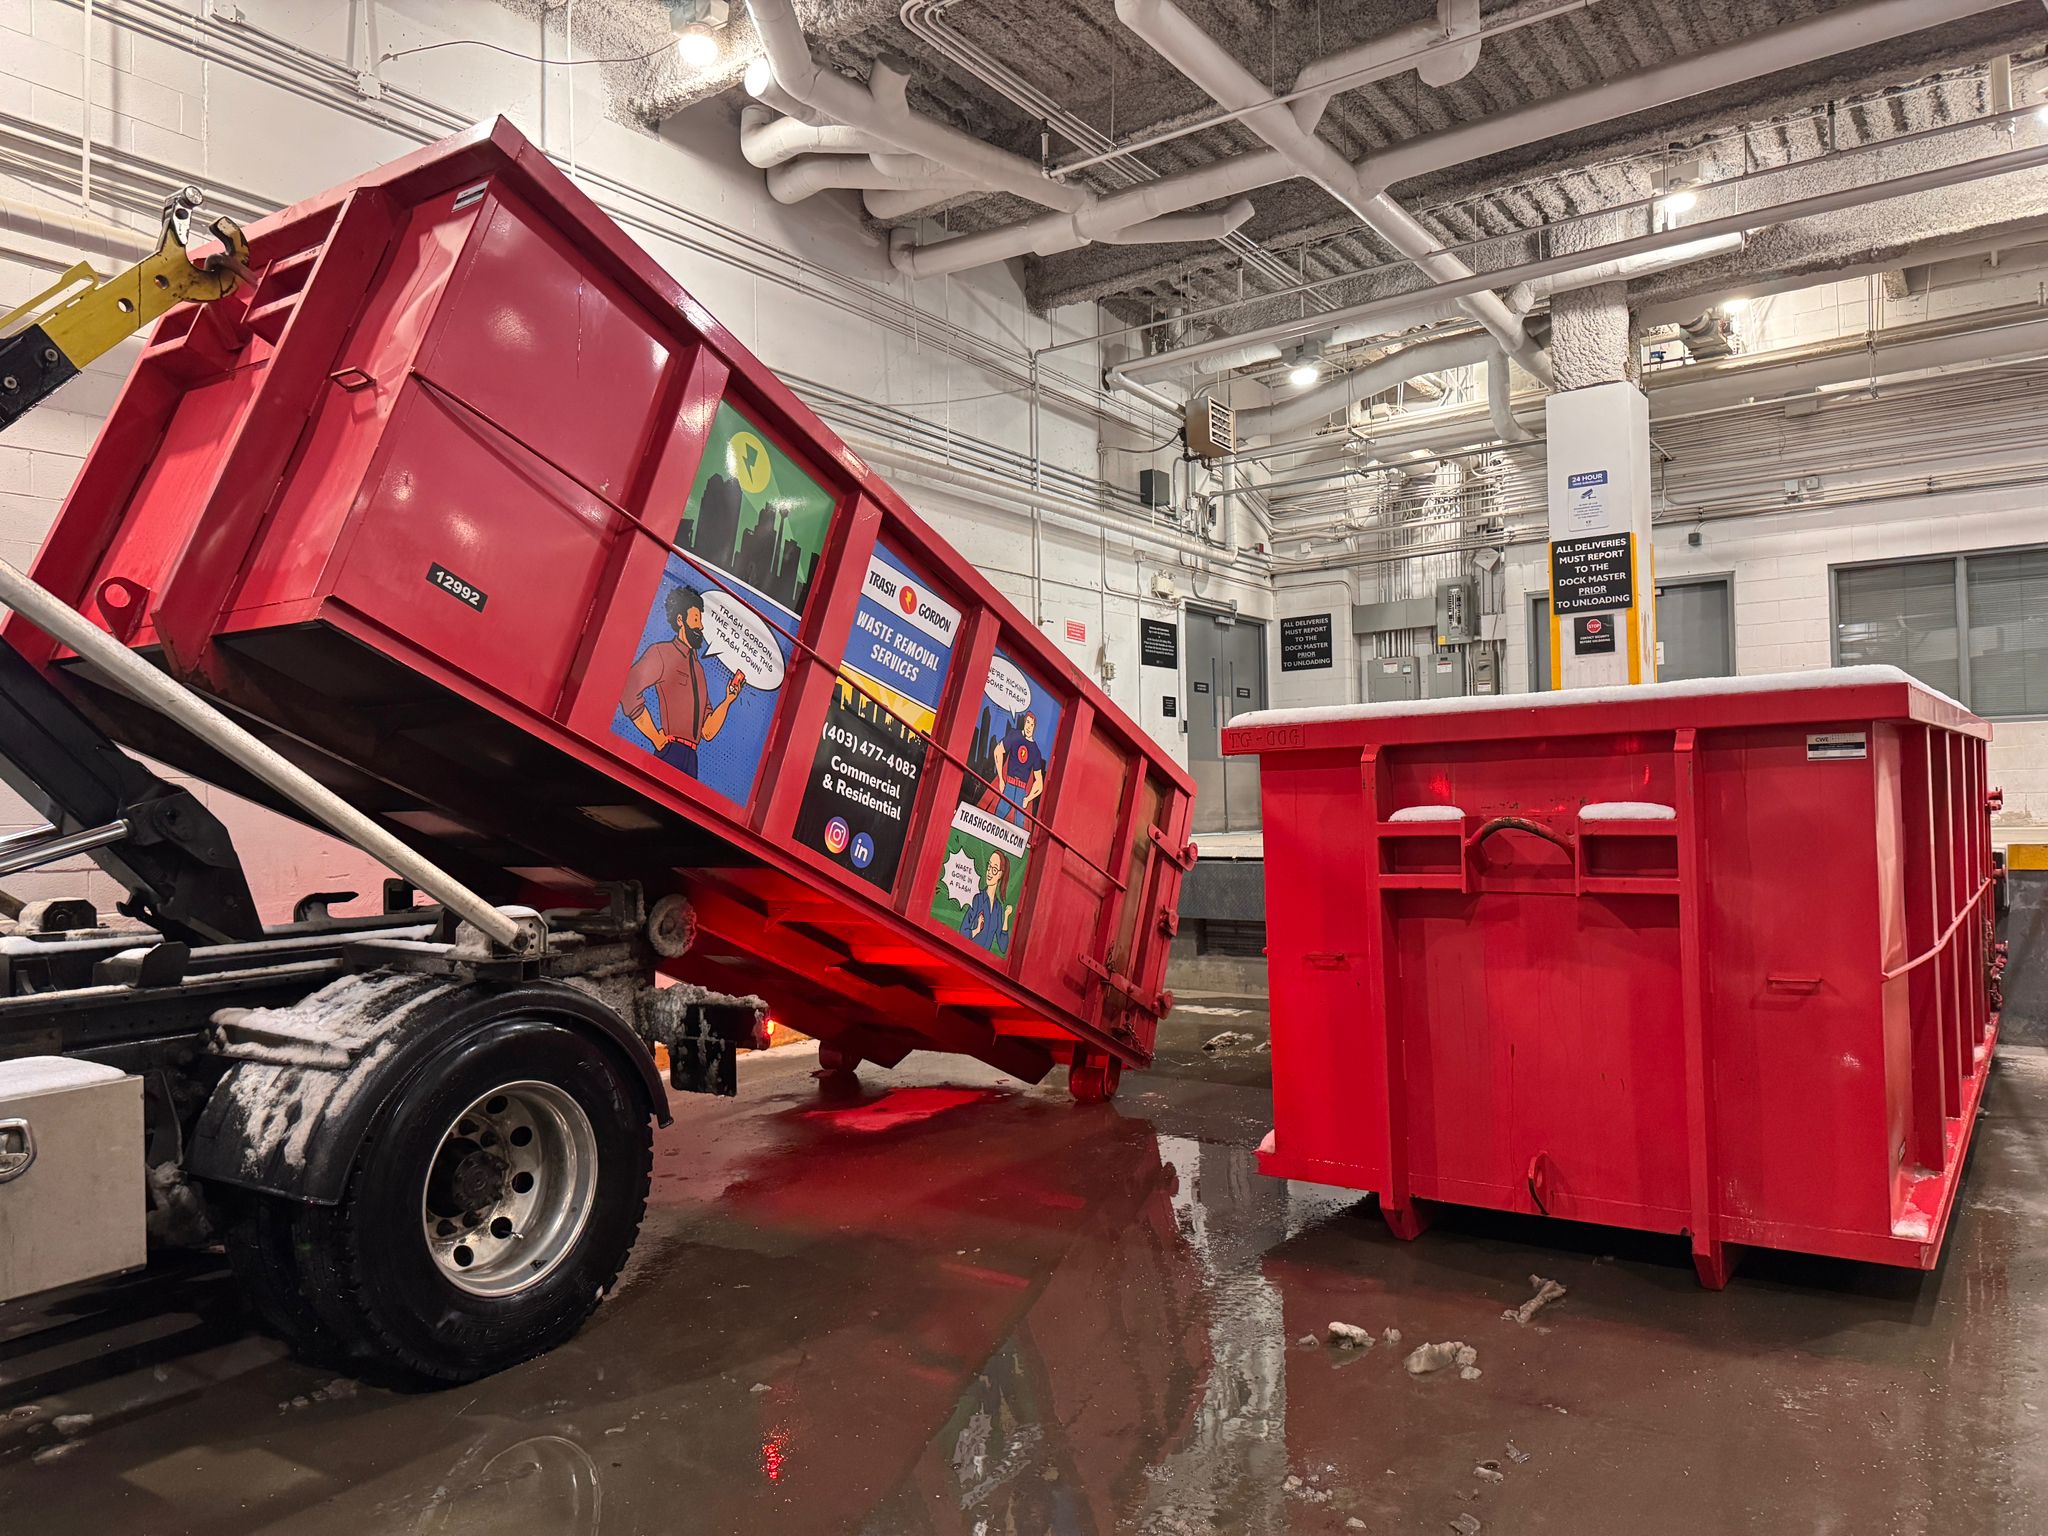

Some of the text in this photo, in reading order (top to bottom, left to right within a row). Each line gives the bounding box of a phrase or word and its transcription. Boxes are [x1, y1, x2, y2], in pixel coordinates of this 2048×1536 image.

[1556, 538, 1627, 554] ALL DELIVERIES
[1559, 550, 1624, 564] MUST REPORT
[1559, 572, 1626, 586] DOCK MASTER
[1575, 563, 1609, 573] TO THE
[437, 571, 480, 605] 12992
[1579, 585, 1607, 595] PRIOR
[869, 570, 951, 632] TRASH GORDON
[1557, 594, 1629, 608] TO UNLOADING
[720, 605, 773, 660] TRASH GORDON,
[1296, 618, 1328, 626] DELIVERIES
[711, 610, 773, 672] TIME TO TAKE THIS
[716, 628, 762, 674] TRASH DOWN!
[857, 611, 939, 671] WASTE REMOVAL
[871, 644, 919, 682] SERVICES
[1294, 658, 1330, 666] UNLOADING
[990, 667, 1027, 695] E'RE KICKING
[822, 722, 917, 779] (403) 477-4082
[831, 756, 900, 799] Commercial
[822, 773, 901, 821] & Residential
[960, 810, 1024, 848] TRASHGORDON.COM
[854, 839, 868, 862] in
[952, 871, 966, 881] GONE
[956, 863, 972, 874] WASTE
[956, 882, 971, 893] FLASH
